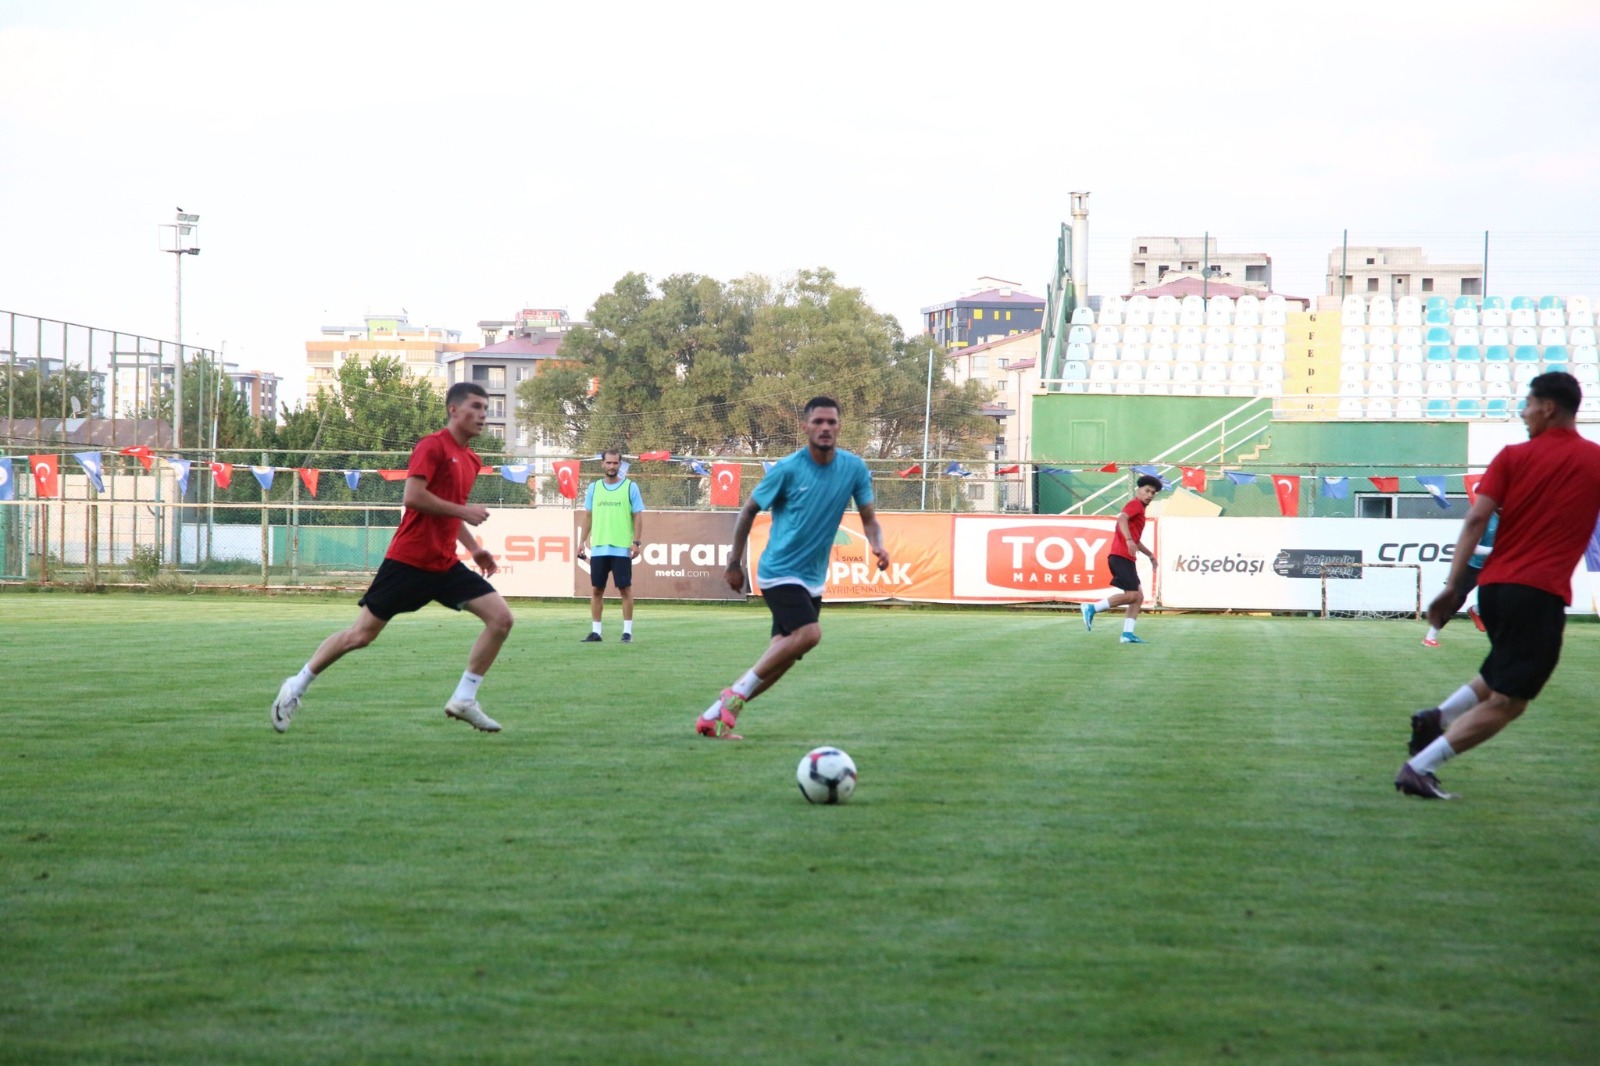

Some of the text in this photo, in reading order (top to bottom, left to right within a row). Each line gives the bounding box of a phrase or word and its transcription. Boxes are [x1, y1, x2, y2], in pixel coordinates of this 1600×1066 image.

[1309, 314, 1316, 322] G
[1308, 332, 1315, 340] F
[1307, 350, 1314, 358] E
[1002, 536, 1107, 571] TOY
[1174, 553, 1265, 576] köşebaşı
[655, 569, 710, 578] metal.com
[825, 562, 913, 585] PRAK
[1302, 566, 1354, 575] resoran
[1013, 572, 1095, 584] MARKET
